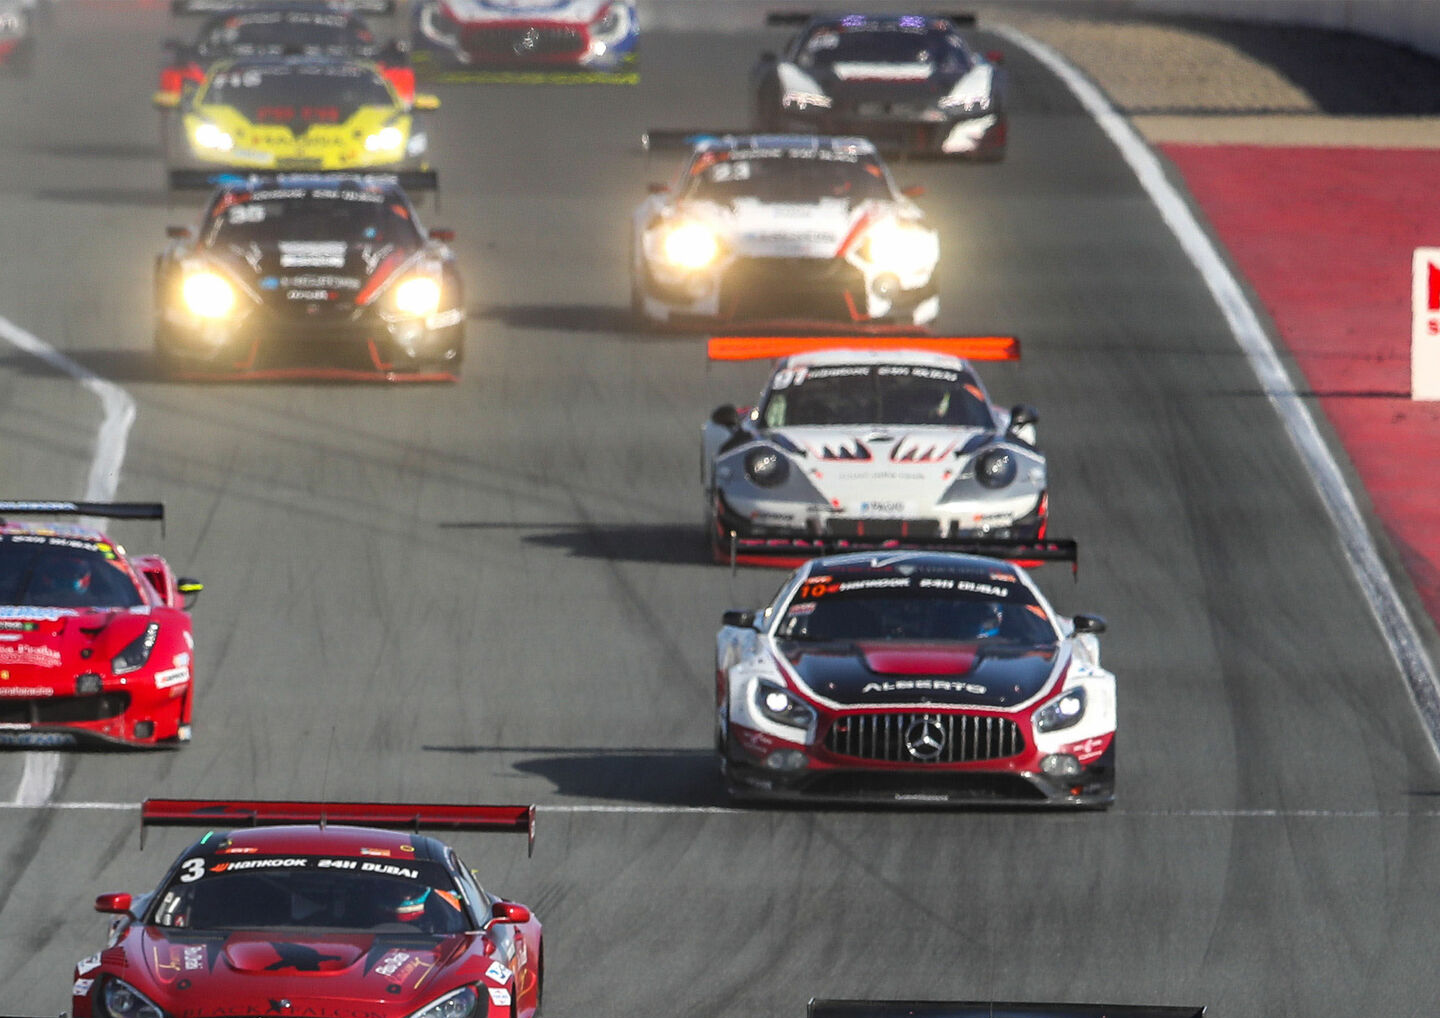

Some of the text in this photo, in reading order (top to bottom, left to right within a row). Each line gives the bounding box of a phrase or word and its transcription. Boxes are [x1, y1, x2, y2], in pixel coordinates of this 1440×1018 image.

[800, 583, 828, 599] 10
[180, 857, 207, 883] 3
[317, 858, 358, 870] 24H
[361, 862, 419, 879] DUBAI
